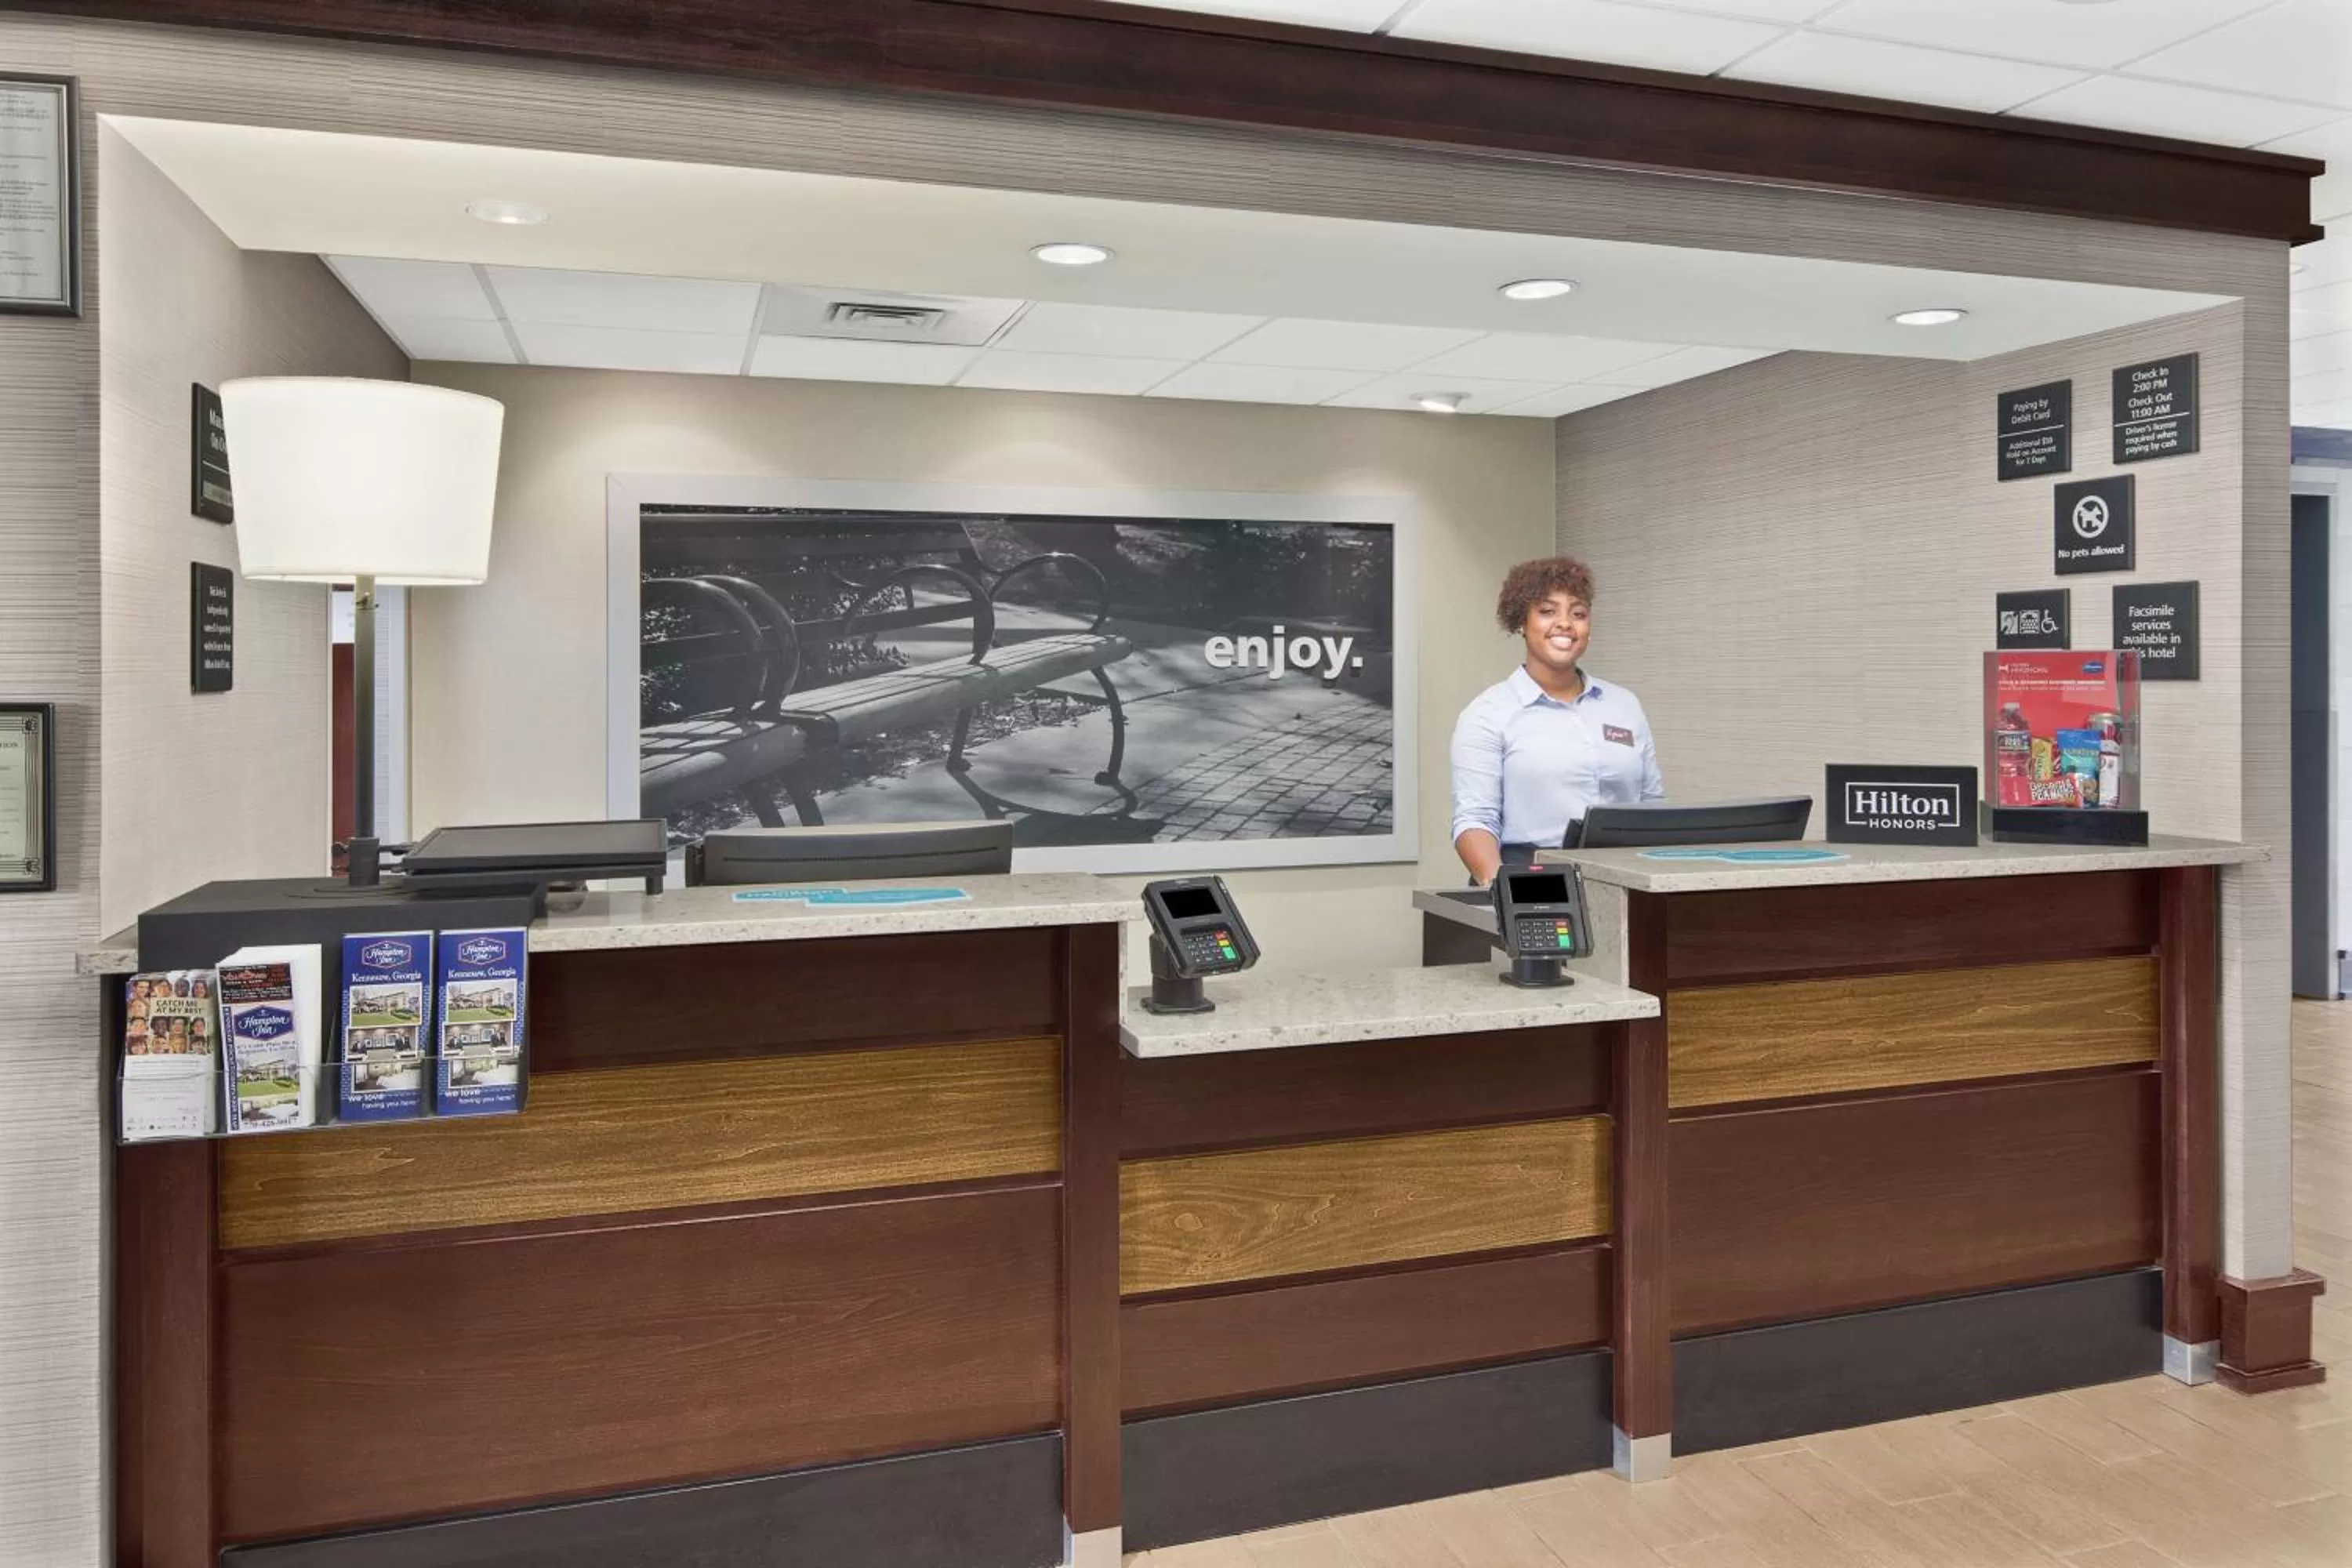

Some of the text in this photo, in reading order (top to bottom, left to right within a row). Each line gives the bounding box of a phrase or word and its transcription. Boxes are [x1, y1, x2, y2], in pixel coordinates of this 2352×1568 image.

[2132, 367, 2169, 381] Check In
[2132, 379, 2168, 393] 2:00 PM
[2013, 398, 2049, 412] Paying by
[2128, 393, 2174, 408] Check Out
[2011, 408, 2051, 424] Debit Card
[2131, 404, 2171, 419] 11:00 AM
[2125, 425, 2151, 435] Driver's
[2125, 430, 2177, 445] required when
[2125, 439, 2177, 456] paying by cash
[2058, 544, 2125, 560] No pets allowed
[2129, 604, 2175, 617] Facsimile
[2132, 619, 2171, 630] services
[2122, 633, 2181, 645] available in
[1204, 625, 1363, 680] enjoy.
[2147, 646, 2176, 658] hotel
[1855, 790, 1950, 815] Hilton
[1869, 818, 1936, 830] HONORS
[366, 947, 407, 958] Hampton
[462, 943, 503, 955] Hampton
[392, 970, 422, 981] Georgia
[488, 966, 517, 977] Georgia
[238, 1015, 289, 1029] Hampton
[252, 1025, 277, 1038] Inn
